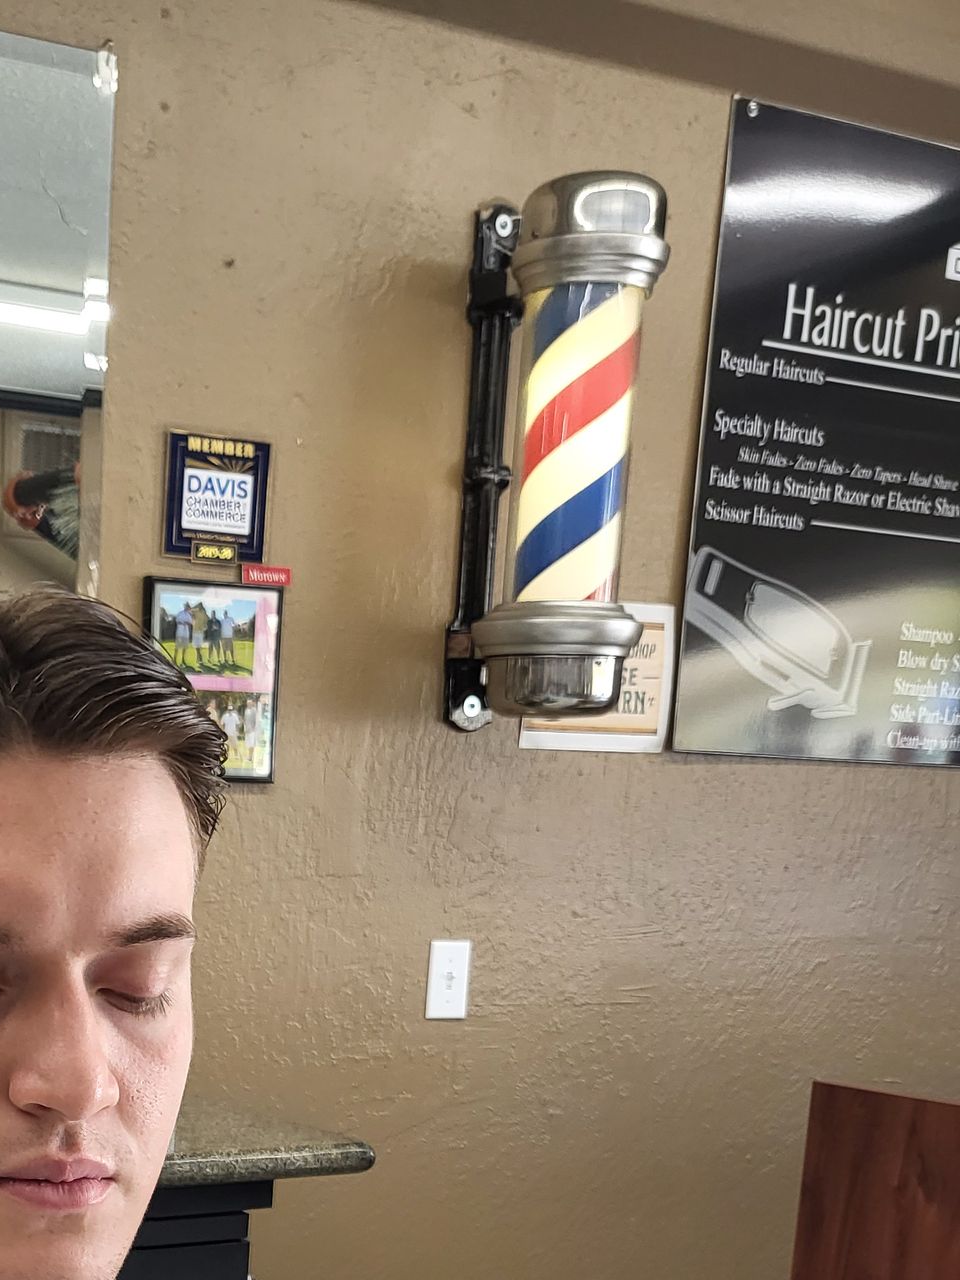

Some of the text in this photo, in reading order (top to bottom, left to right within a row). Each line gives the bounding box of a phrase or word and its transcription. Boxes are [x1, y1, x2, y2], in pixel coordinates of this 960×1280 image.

[783, 282, 960, 369] Haircut Pri
[719, 348, 825, 385] Regular Haircuts
[713, 408, 825, 447] Specialty Haircuts
[188, 436, 255, 458] MEMBER
[738, 446, 761, 463] Skin
[760, 449, 789, 468] Fades
[793, 454, 817, 471] Zero
[817, 457, 844, 475] Fades
[849, 463, 873, 479] Zero
[873, 465, 903, 485] Tapers
[907, 470, 933, 488] Head
[187, 474, 249, 500] DAVIS
[709, 464, 741, 489] Fade
[743, 470, 771, 493] with
[772, 479, 782, 494] a
[783, 475, 833, 505] Straight
[833, 482, 870, 507] Razor
[870, 493, 886, 508] or
[886, 490, 933, 514] Electric
[185, 507, 246, 523] COMMERCE
[186, 496, 242, 511] CHAMBER
[704, 498, 805, 531] Scissor Haircuts
[900, 621, 954, 647] Shampoo
[897, 648, 928, 669] Blow
[930, 652, 950, 675] dry
[893, 677, 938, 701] Straight
[889, 703, 916, 722] Side
